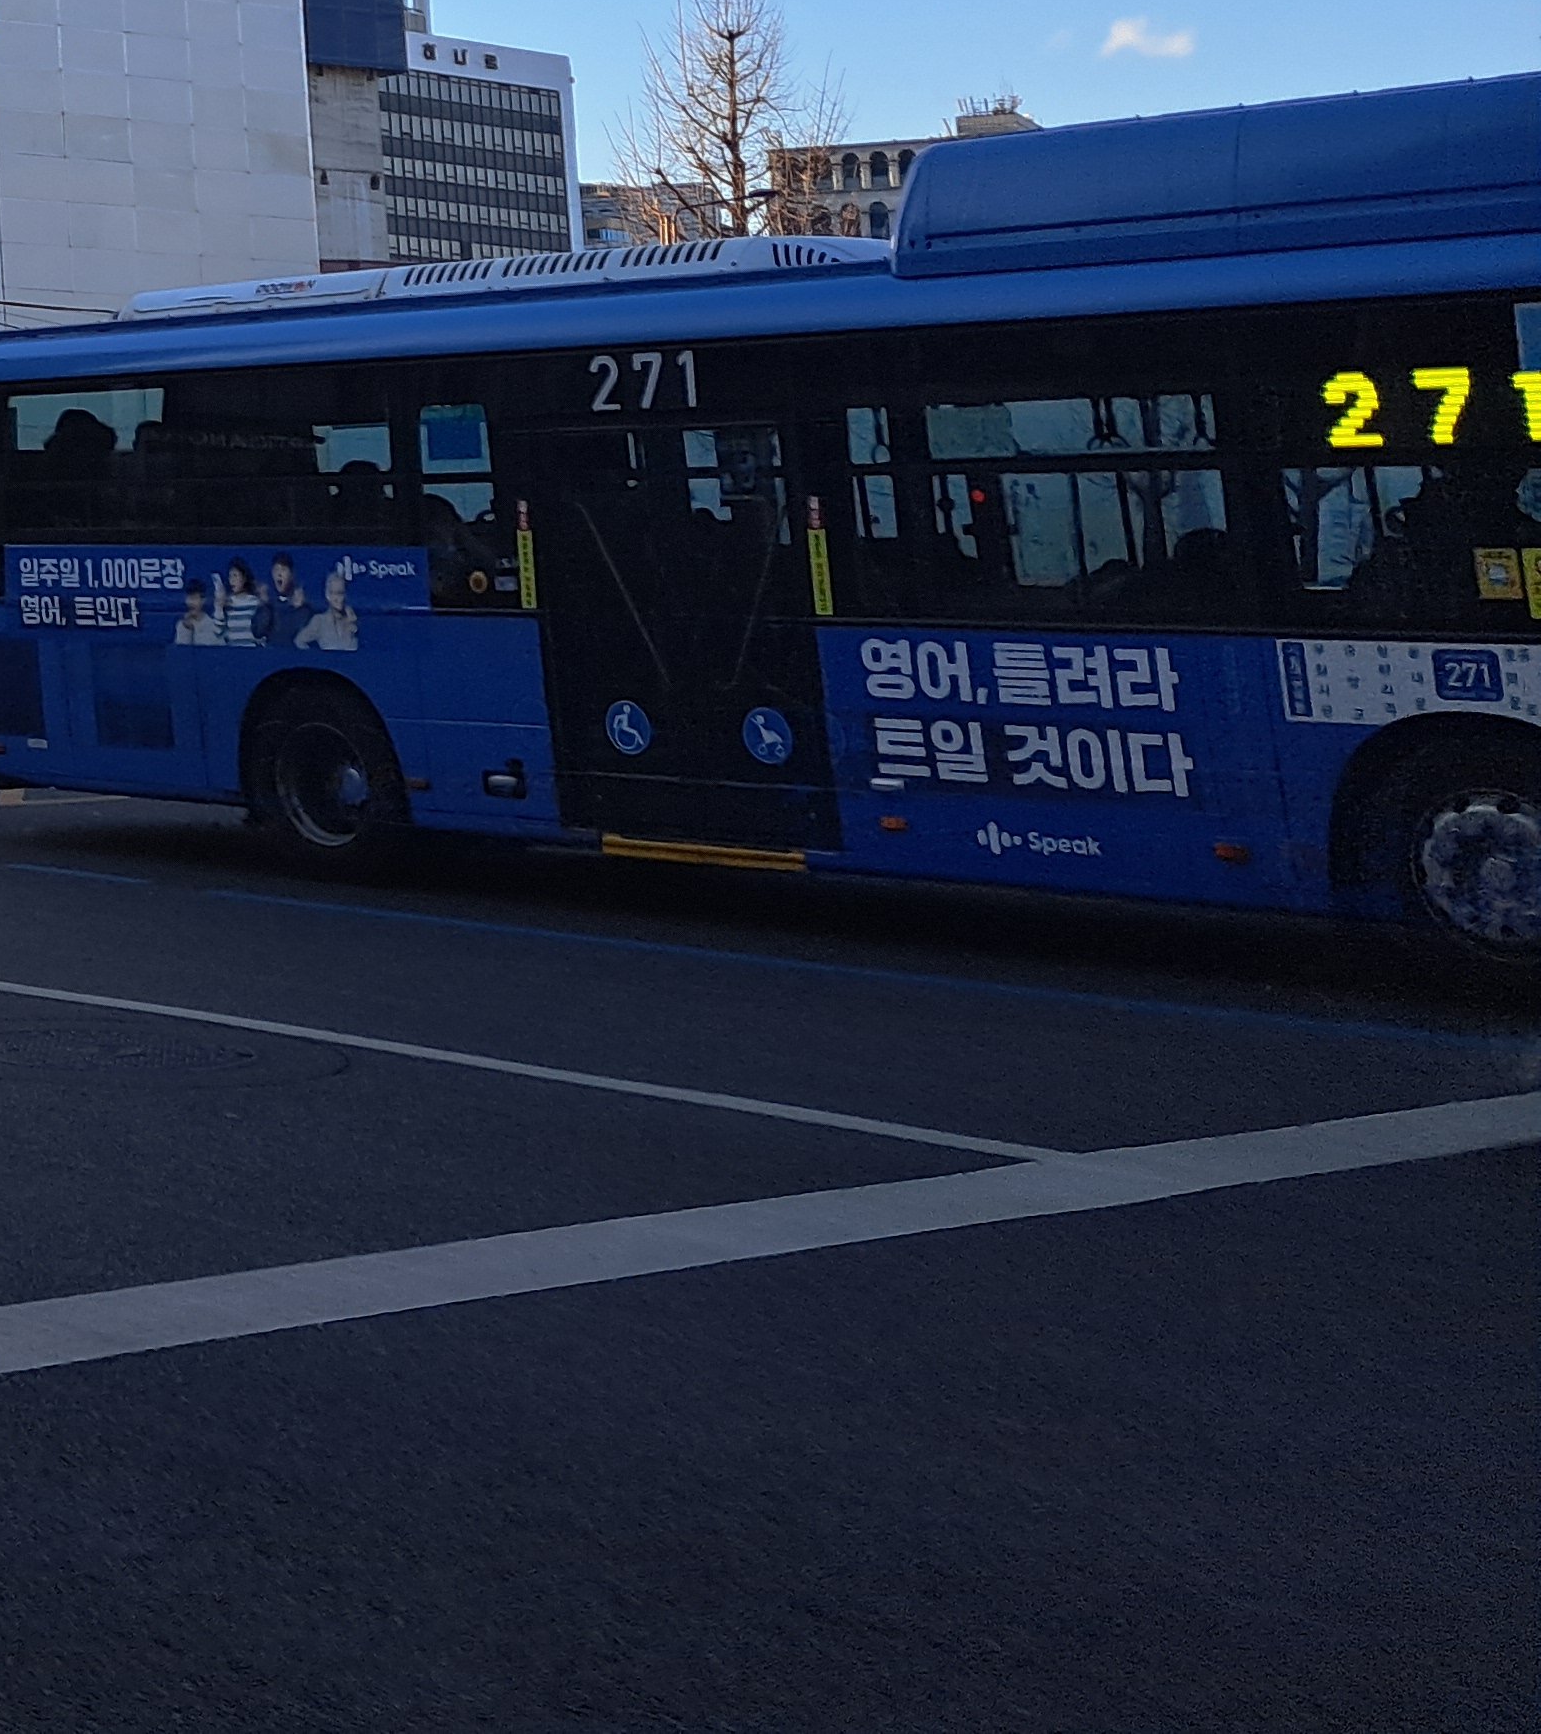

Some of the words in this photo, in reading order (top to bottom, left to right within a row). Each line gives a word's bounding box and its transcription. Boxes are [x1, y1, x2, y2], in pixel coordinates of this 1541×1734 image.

[589, 350, 697, 412] 271
[1321, 367, 1541, 448] 271
[20, 557, 81, 588] 일주일
[85, 557, 185, 589] 1,000문장
[369, 560, 415, 579] Speak
[21, 595, 67, 626] 영어,
[74, 596, 140, 628] 트인다
[1444, 662, 1492, 690] 271
[874, 717, 989, 784] 트일
[1003, 723, 1194, 798] 것이다
[1028, 831, 1104, 857] Speak
